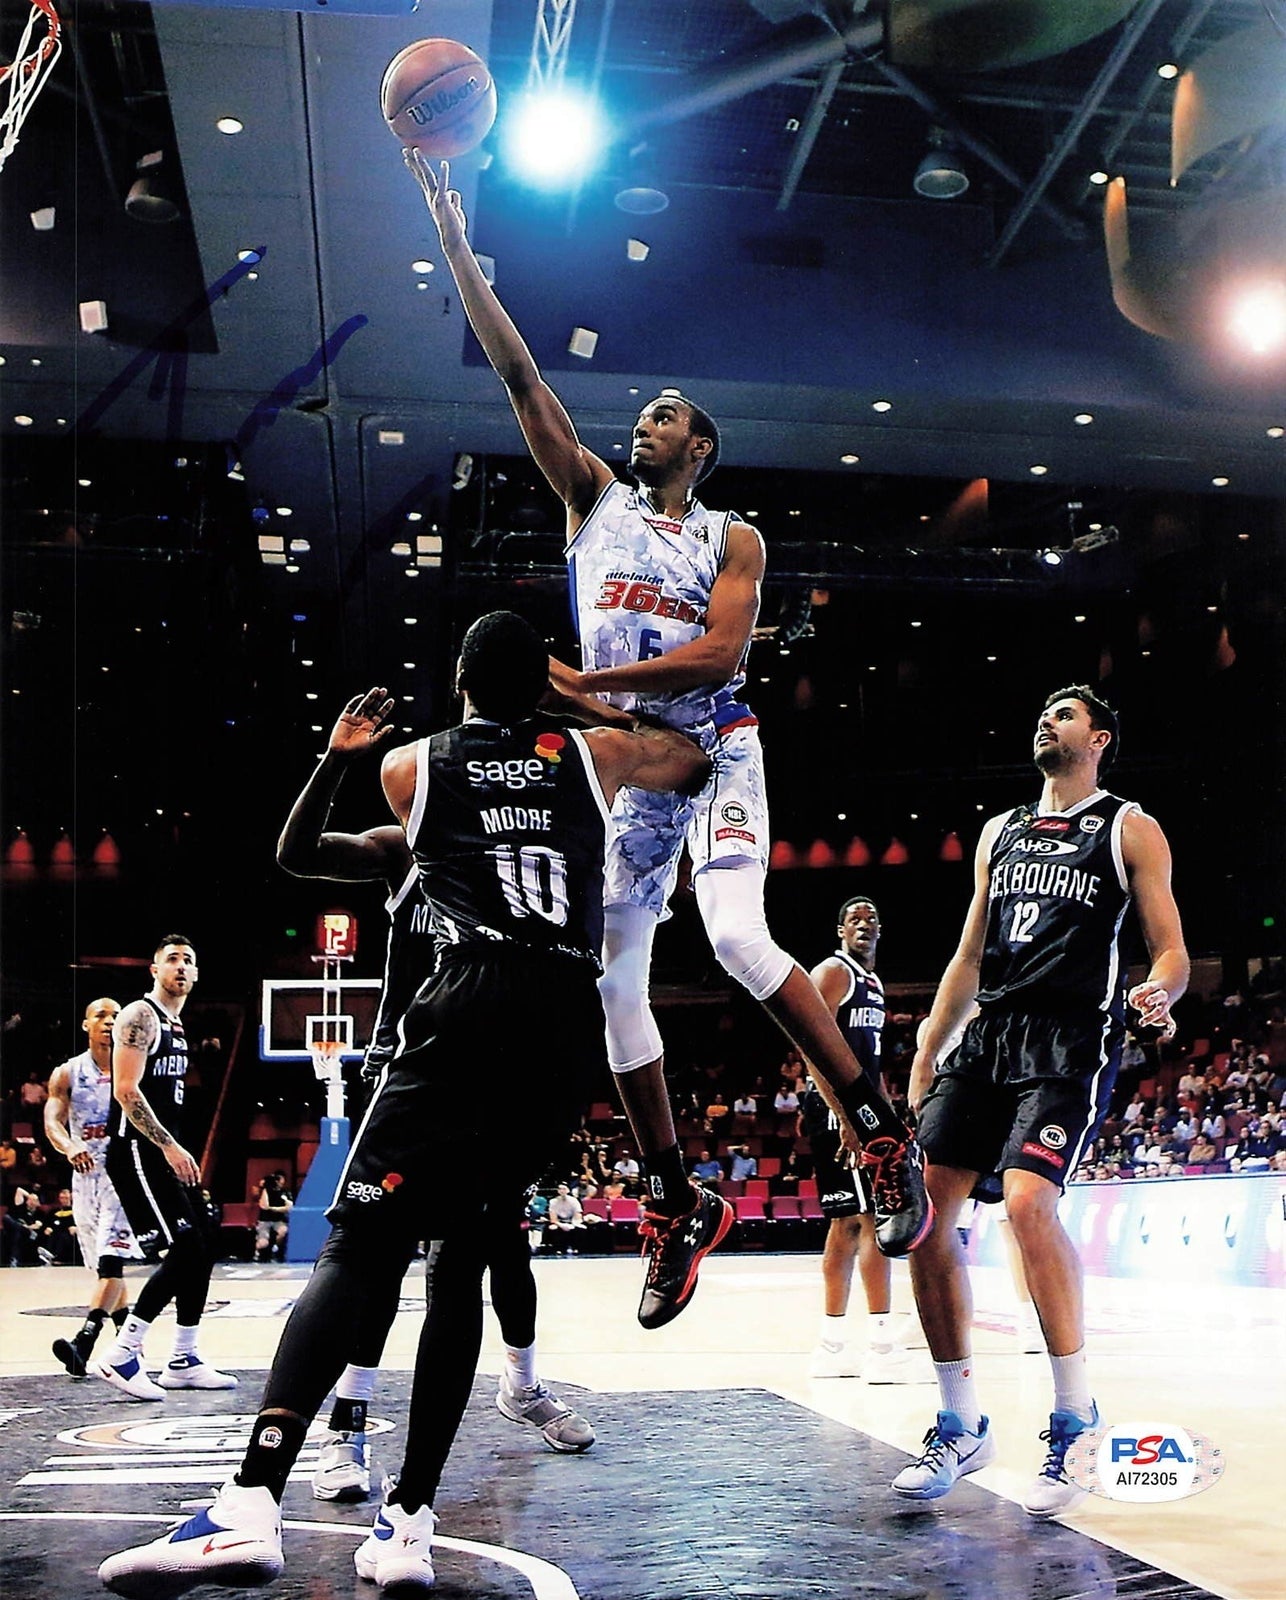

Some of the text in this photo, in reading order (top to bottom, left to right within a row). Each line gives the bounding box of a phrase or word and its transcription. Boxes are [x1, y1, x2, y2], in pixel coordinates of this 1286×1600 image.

[406, 76, 479, 125] Wilson
[466, 759, 543, 789] sage
[480, 806, 552, 834] MOORE
[1011, 838, 1053, 852] AHG
[485, 845, 569, 927] 10
[1009, 901, 1040, 942] 12
[174, 1080, 184, 1105] 6
[347, 1181, 383, 1203] sage
